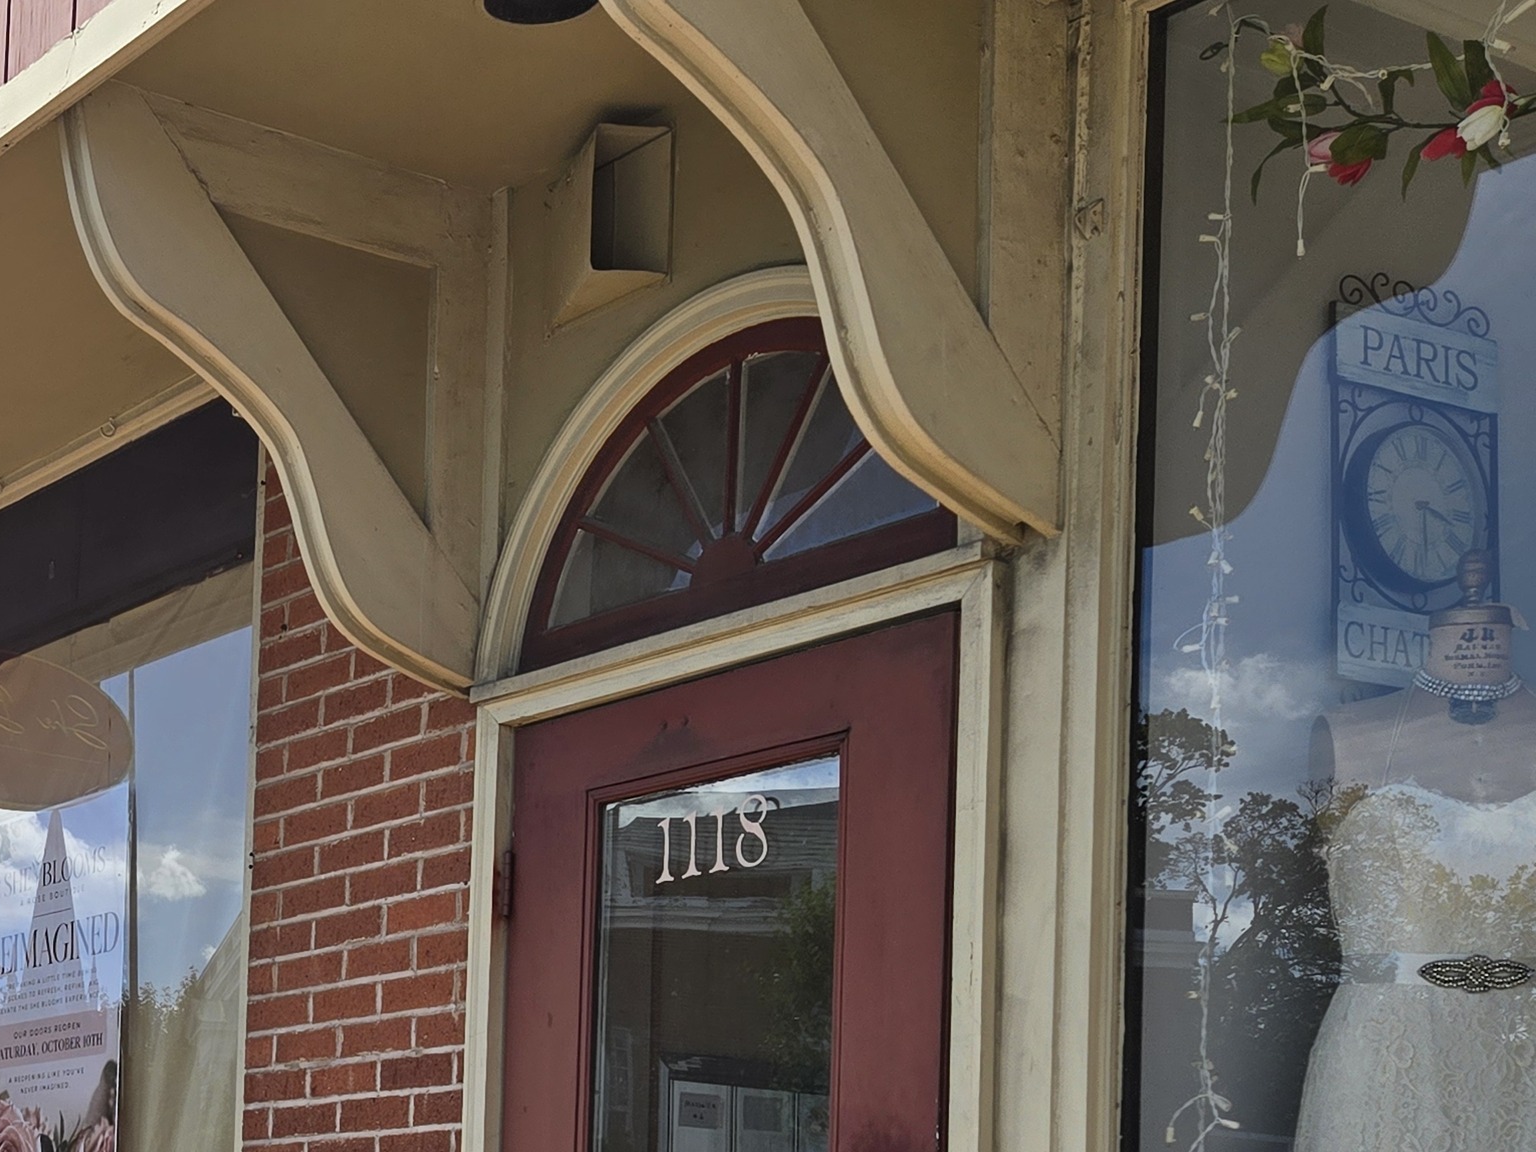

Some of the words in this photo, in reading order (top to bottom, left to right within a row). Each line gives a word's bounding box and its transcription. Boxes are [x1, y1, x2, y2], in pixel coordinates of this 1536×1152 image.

[1359, 324, 1479, 392] PARIS
[655, 794, 768, 884] 1118
[42, 847, 107, 887] BLOOMS
[13, 1030, 27, 1040] OUR
[30, 1025, 52, 1037] DOORS
[54, 1021, 81, 1033] REOPEN
[41, 1036, 81, 1054] OCTOBER
[83, 1032, 104, 1048] 10TH
